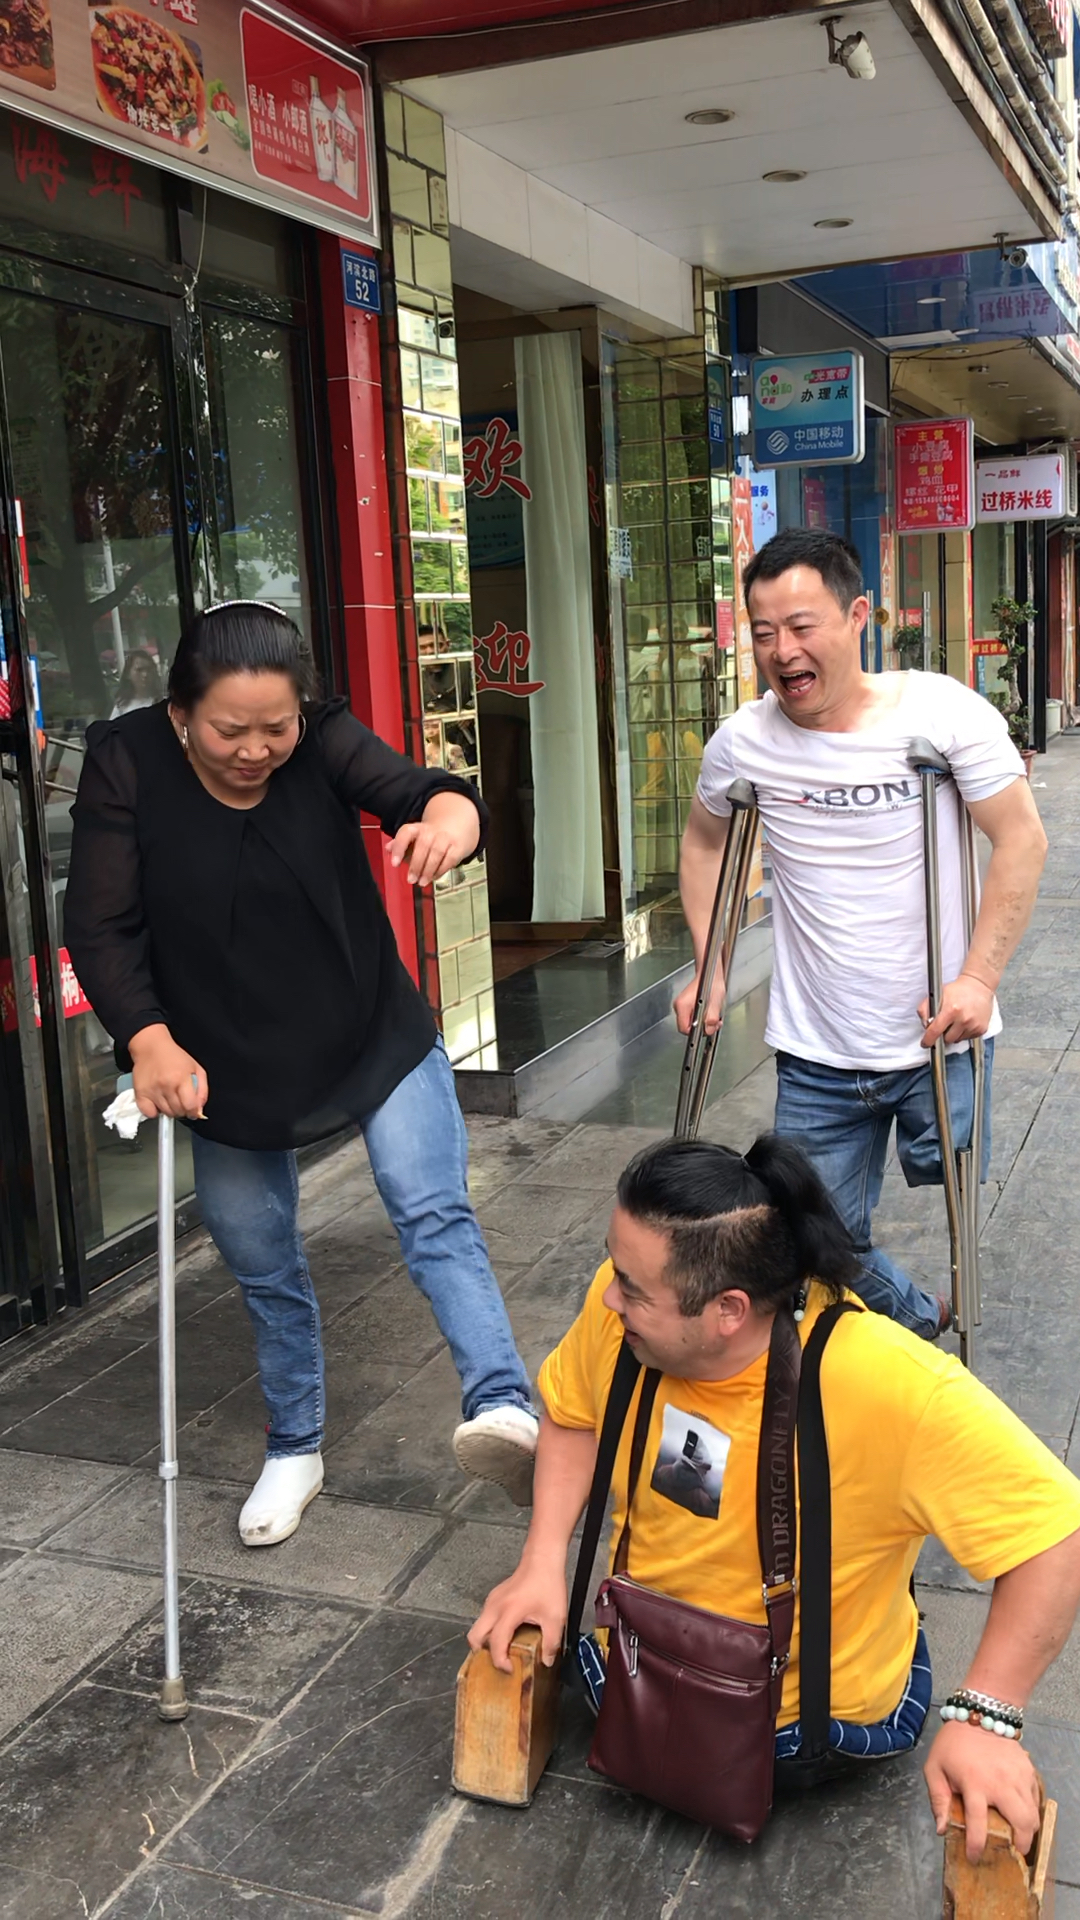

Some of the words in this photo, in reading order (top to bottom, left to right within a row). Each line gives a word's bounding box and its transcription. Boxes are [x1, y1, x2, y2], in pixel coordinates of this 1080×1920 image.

[355, 279, 370, 302] 52
[801, 384, 849, 403] 办理点
[794, 425, 844, 441] 中国移动
[794, 442, 817, 452] China
[818, 439, 844, 449] Mobile
[981, 489, 1053, 512] 过桥米线
[770, 1387, 791, 1546] DRAGONFLY
